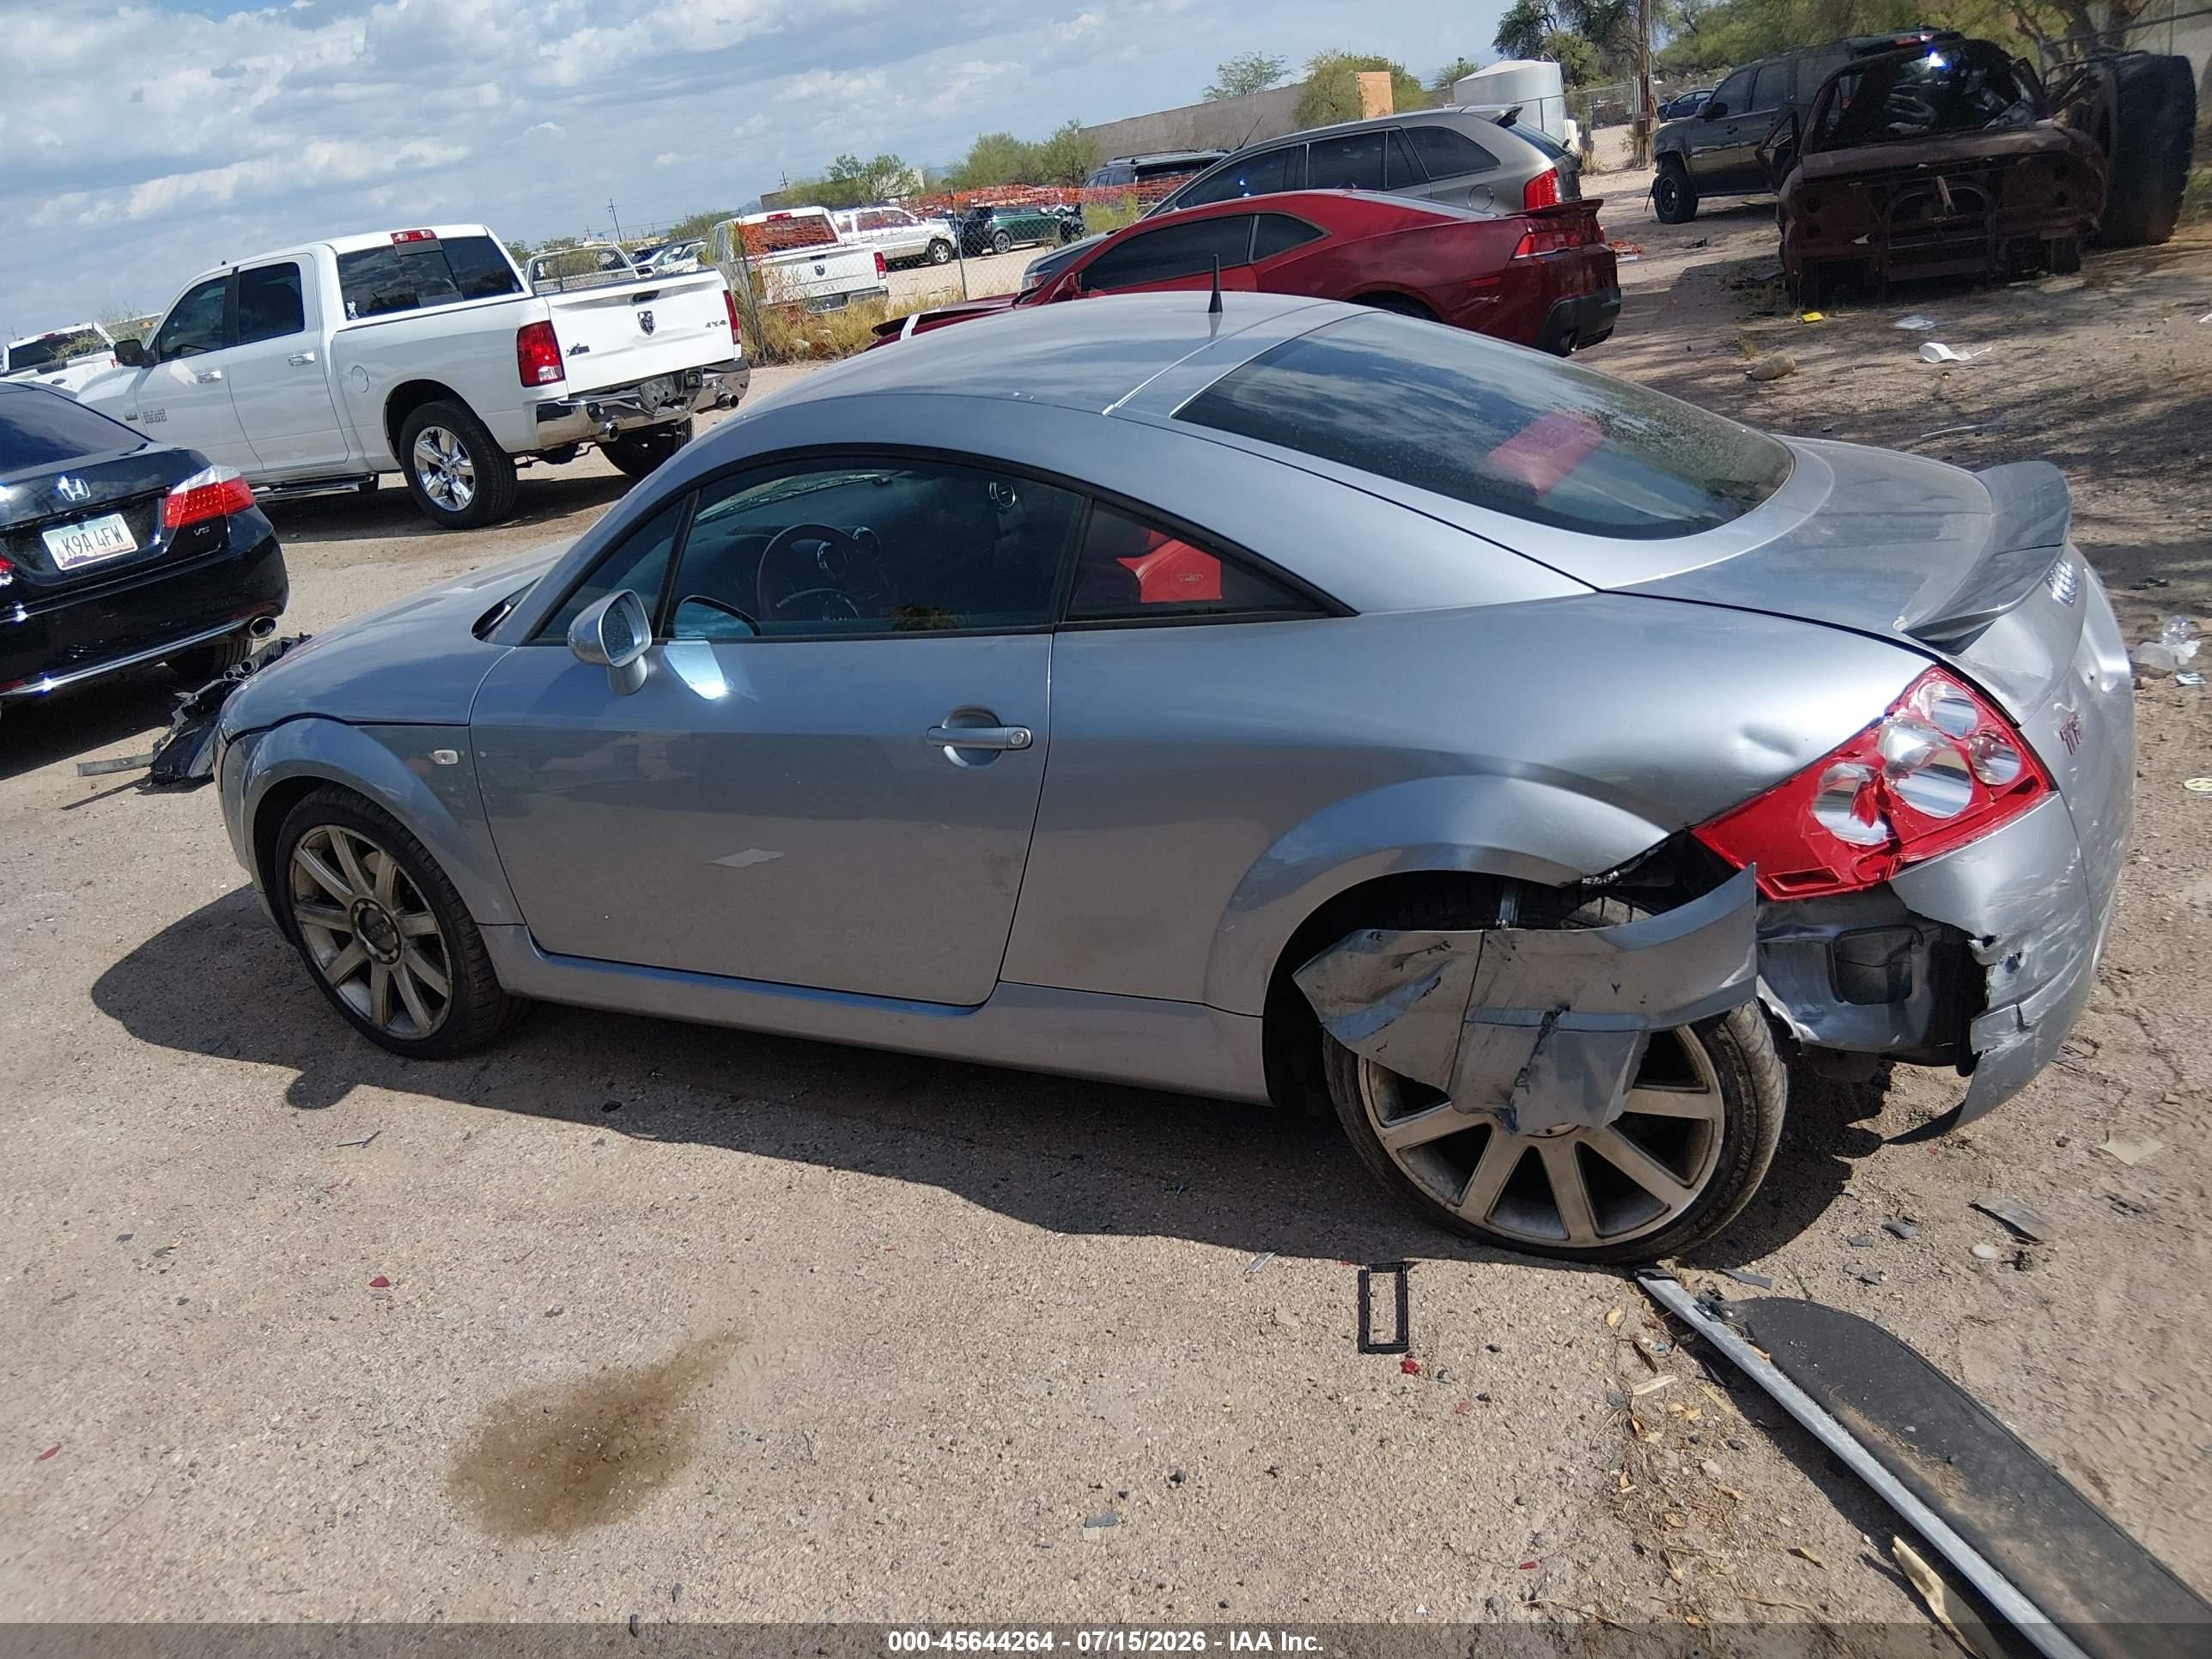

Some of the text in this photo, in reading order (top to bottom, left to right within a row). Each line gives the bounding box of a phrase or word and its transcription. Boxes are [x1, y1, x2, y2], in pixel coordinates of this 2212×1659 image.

[62, 525, 125, 556] K9A 4FW
[193, 526, 210, 536] V6
